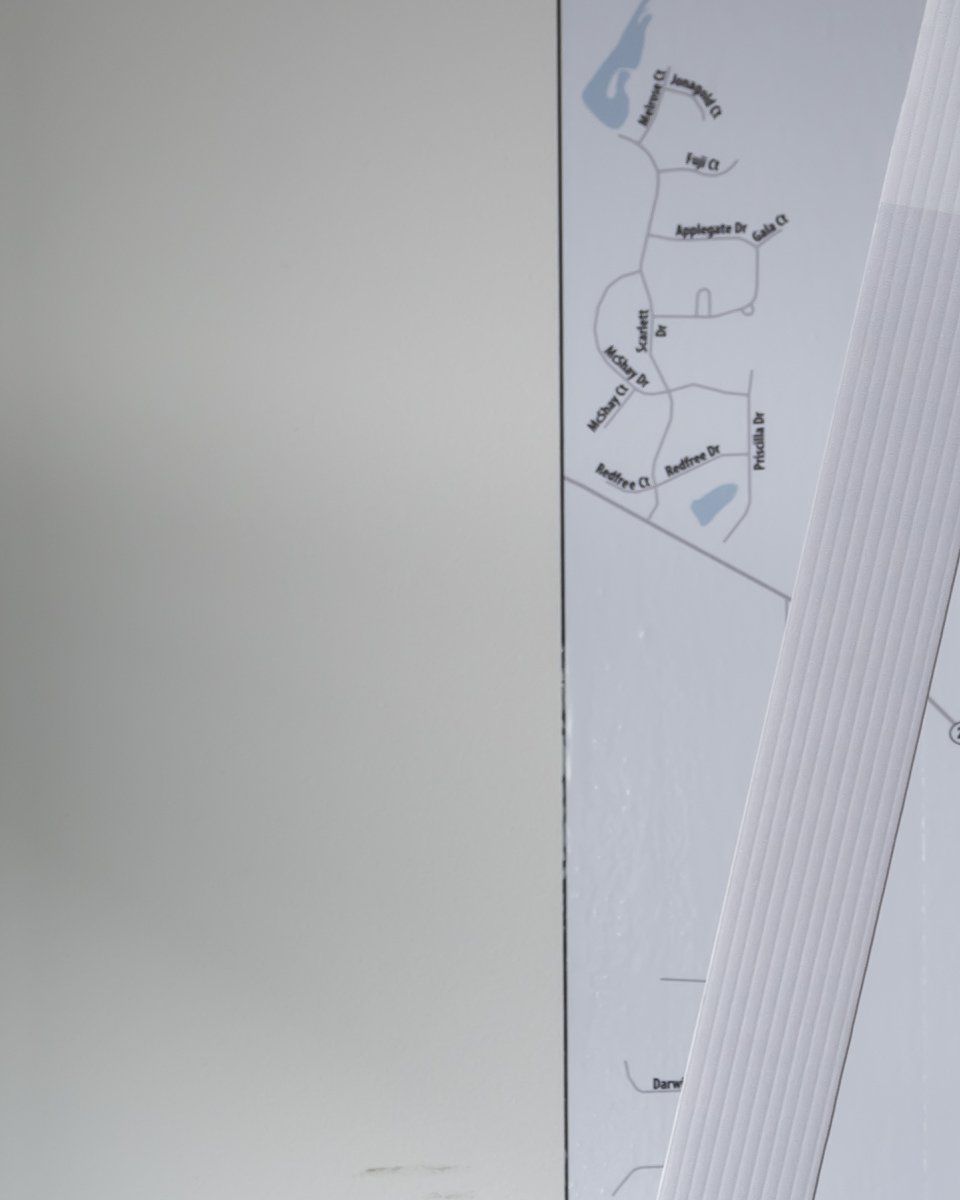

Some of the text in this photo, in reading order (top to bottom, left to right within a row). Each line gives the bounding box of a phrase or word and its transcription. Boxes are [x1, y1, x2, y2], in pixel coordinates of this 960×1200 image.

[653, 69, 667, 81] Ct
[709, 105, 722, 119] Ct
[685, 152, 720, 171] Fuji Ct
[675, 221, 748, 240] Applegate Dr
[752, 214, 789, 242] Gala Ct
[635, 309, 667, 354] Scarlett Dr
[604, 344, 650, 388] McShay Dr
[587, 383, 629, 433] McShay Ct
[753, 411, 765, 471] Priscilla Dr
[664, 444, 721, 478] Redfree Dr
[595, 462, 651, 491] Redfree Ct
[653, 1076, 684, 1090] Darw
